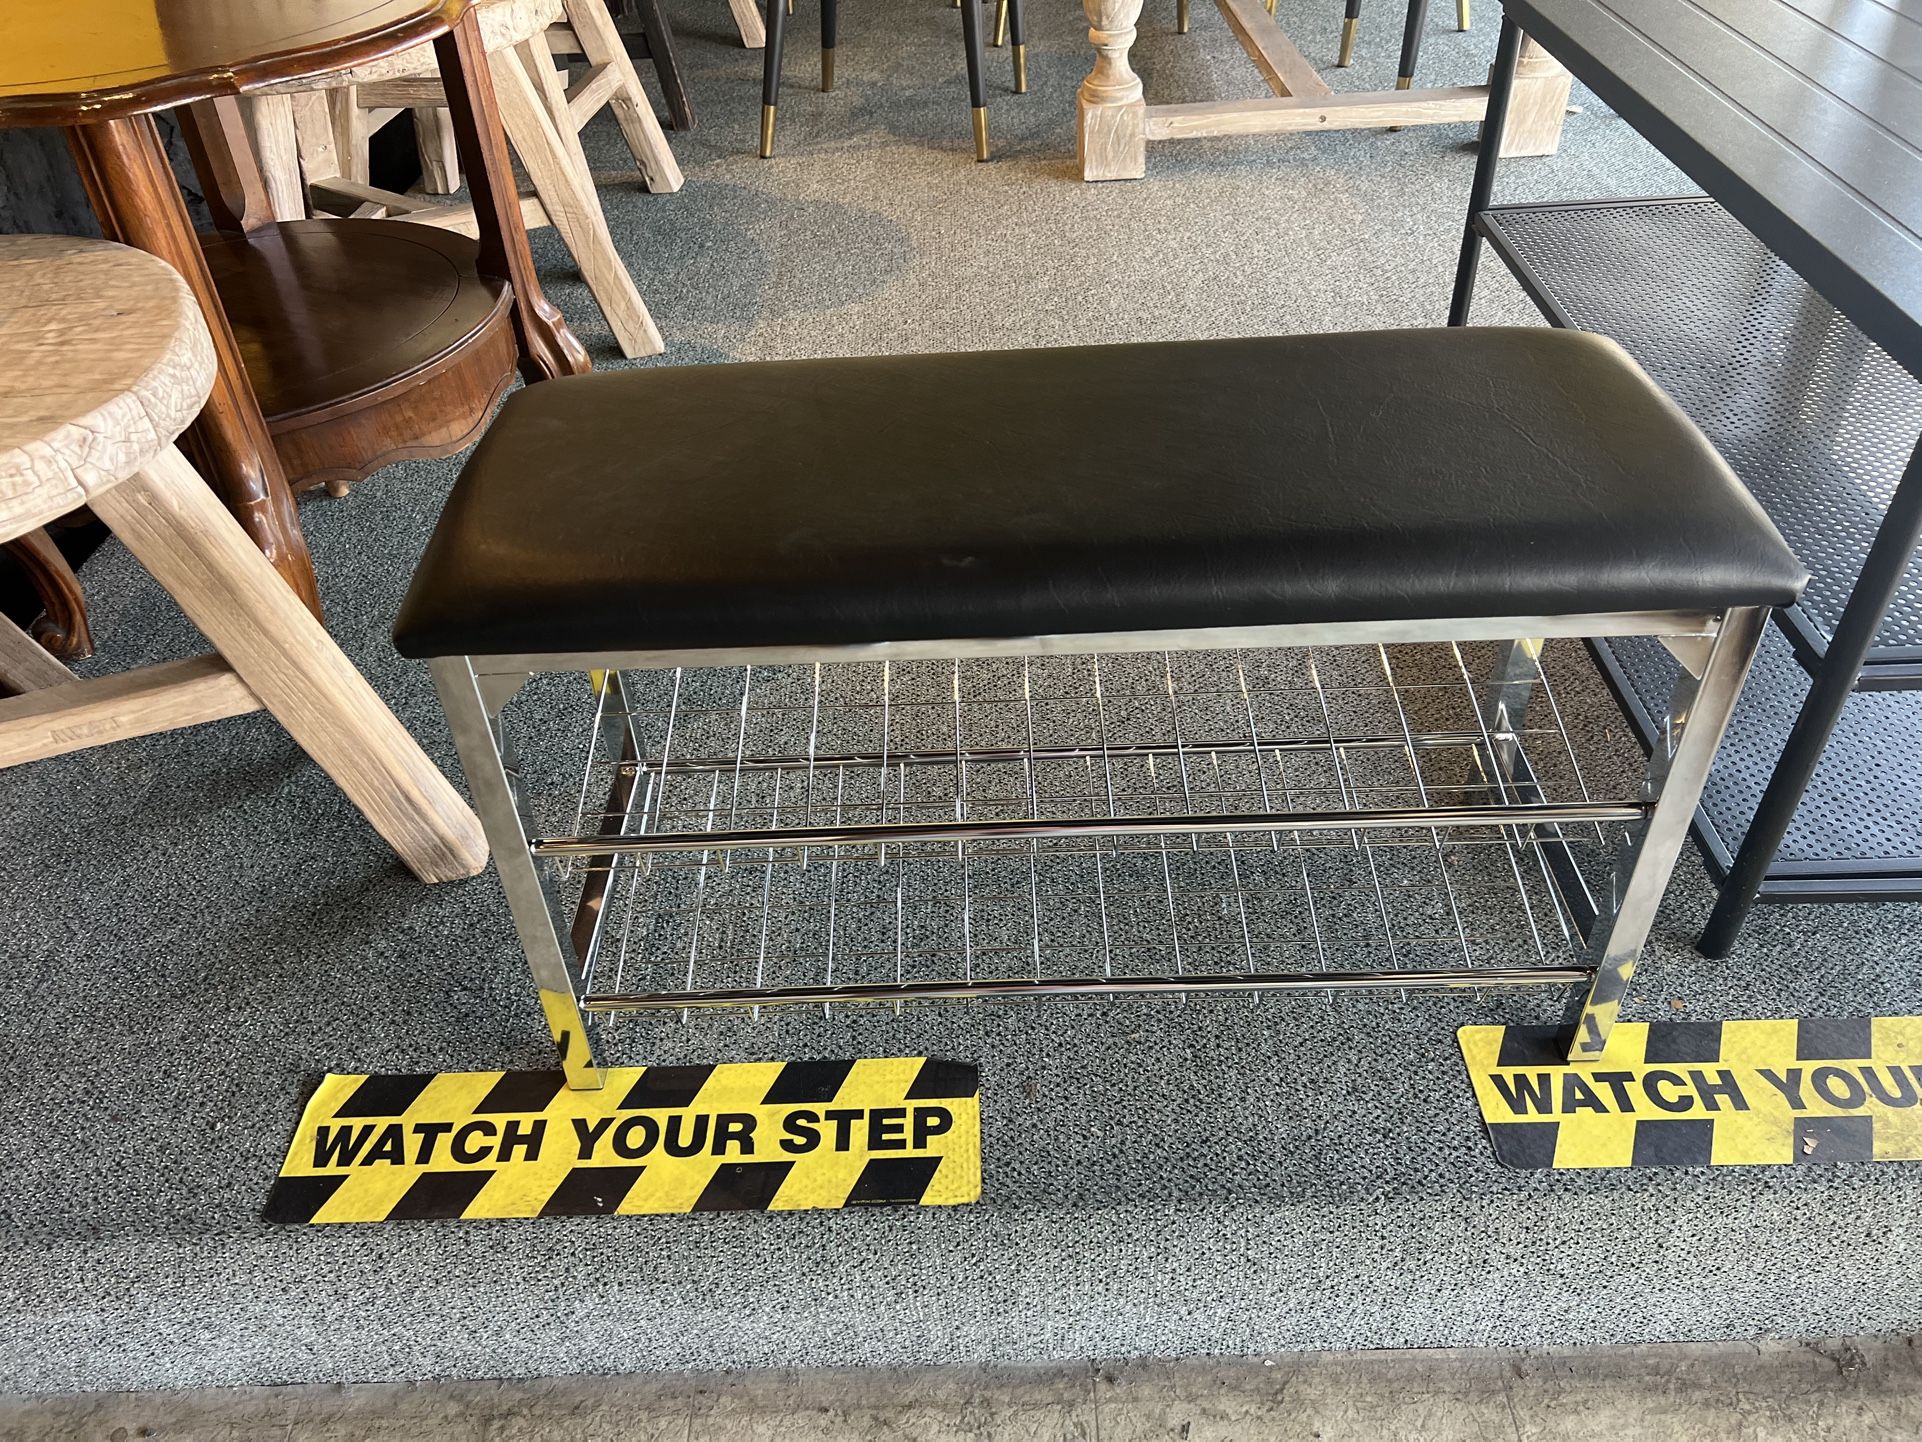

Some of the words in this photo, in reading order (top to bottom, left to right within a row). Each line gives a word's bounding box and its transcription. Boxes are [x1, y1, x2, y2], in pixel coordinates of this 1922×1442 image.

[1488, 1069, 1750, 1115] WATCH
[1755, 1065, 1922, 1110] YOU
[312, 1119, 548, 1168] WATCH
[569, 1113, 758, 1160] YOUR
[779, 1106, 954, 1154] STEP
